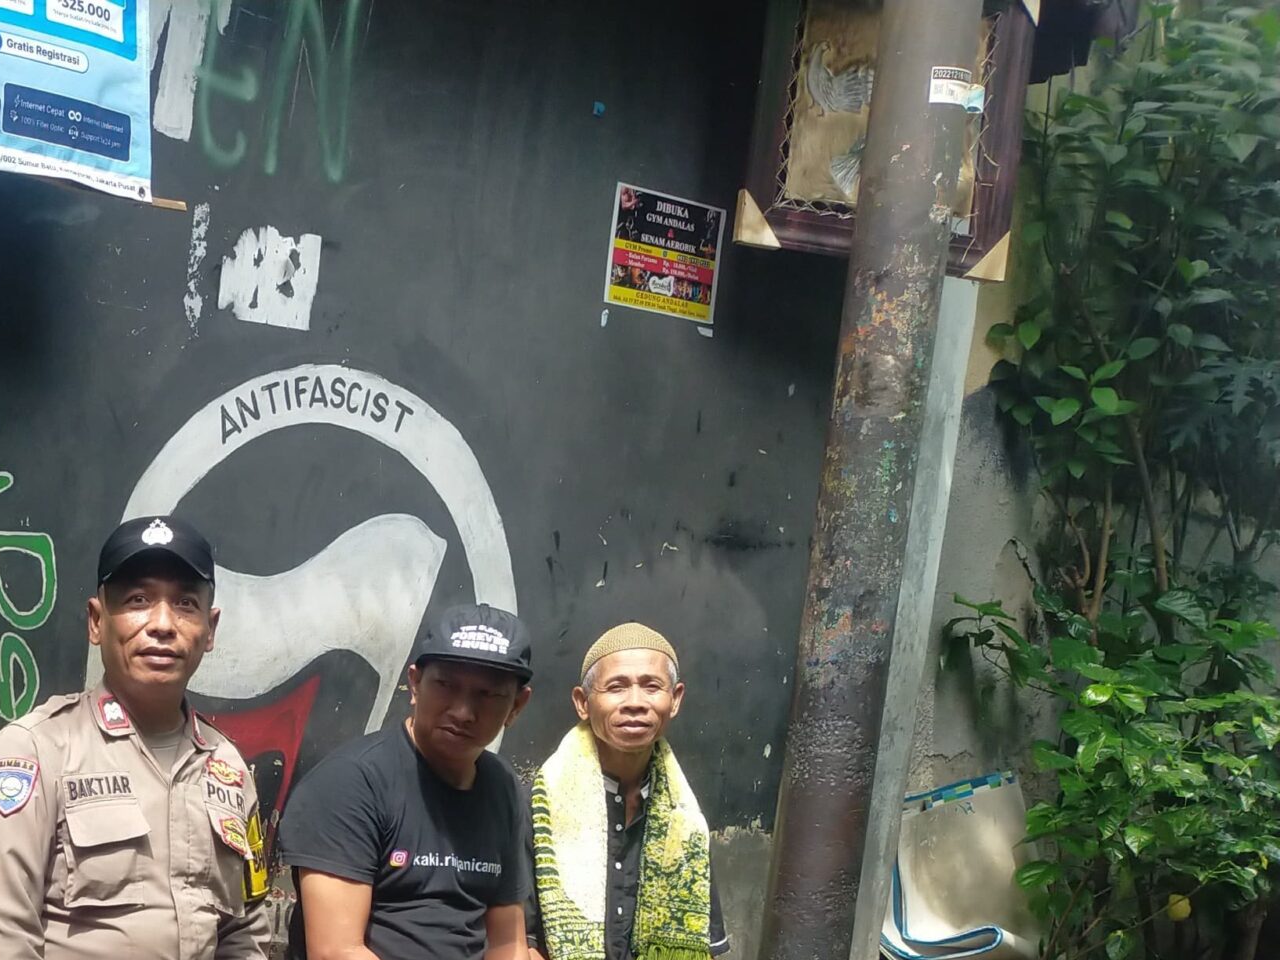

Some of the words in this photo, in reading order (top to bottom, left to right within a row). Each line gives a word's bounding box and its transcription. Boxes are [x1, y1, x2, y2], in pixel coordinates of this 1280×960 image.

[6, 38, 34, 53] Gratis
[36, 45, 80, 65] Registrasi
[20, 99, 45, 111] Internet
[46, 106, 65, 118] Cepat
[656, 201, 689, 219] DIBUKA
[645, 212, 663, 225] GYM
[663, 216, 695, 232] ANDALAS
[641, 233, 669, 248] SENAM
[668, 239, 696, 254] AEROBIK
[219, 376, 414, 444] ANTIFASCIST
[70, 776, 132, 800] BAKTIAR
